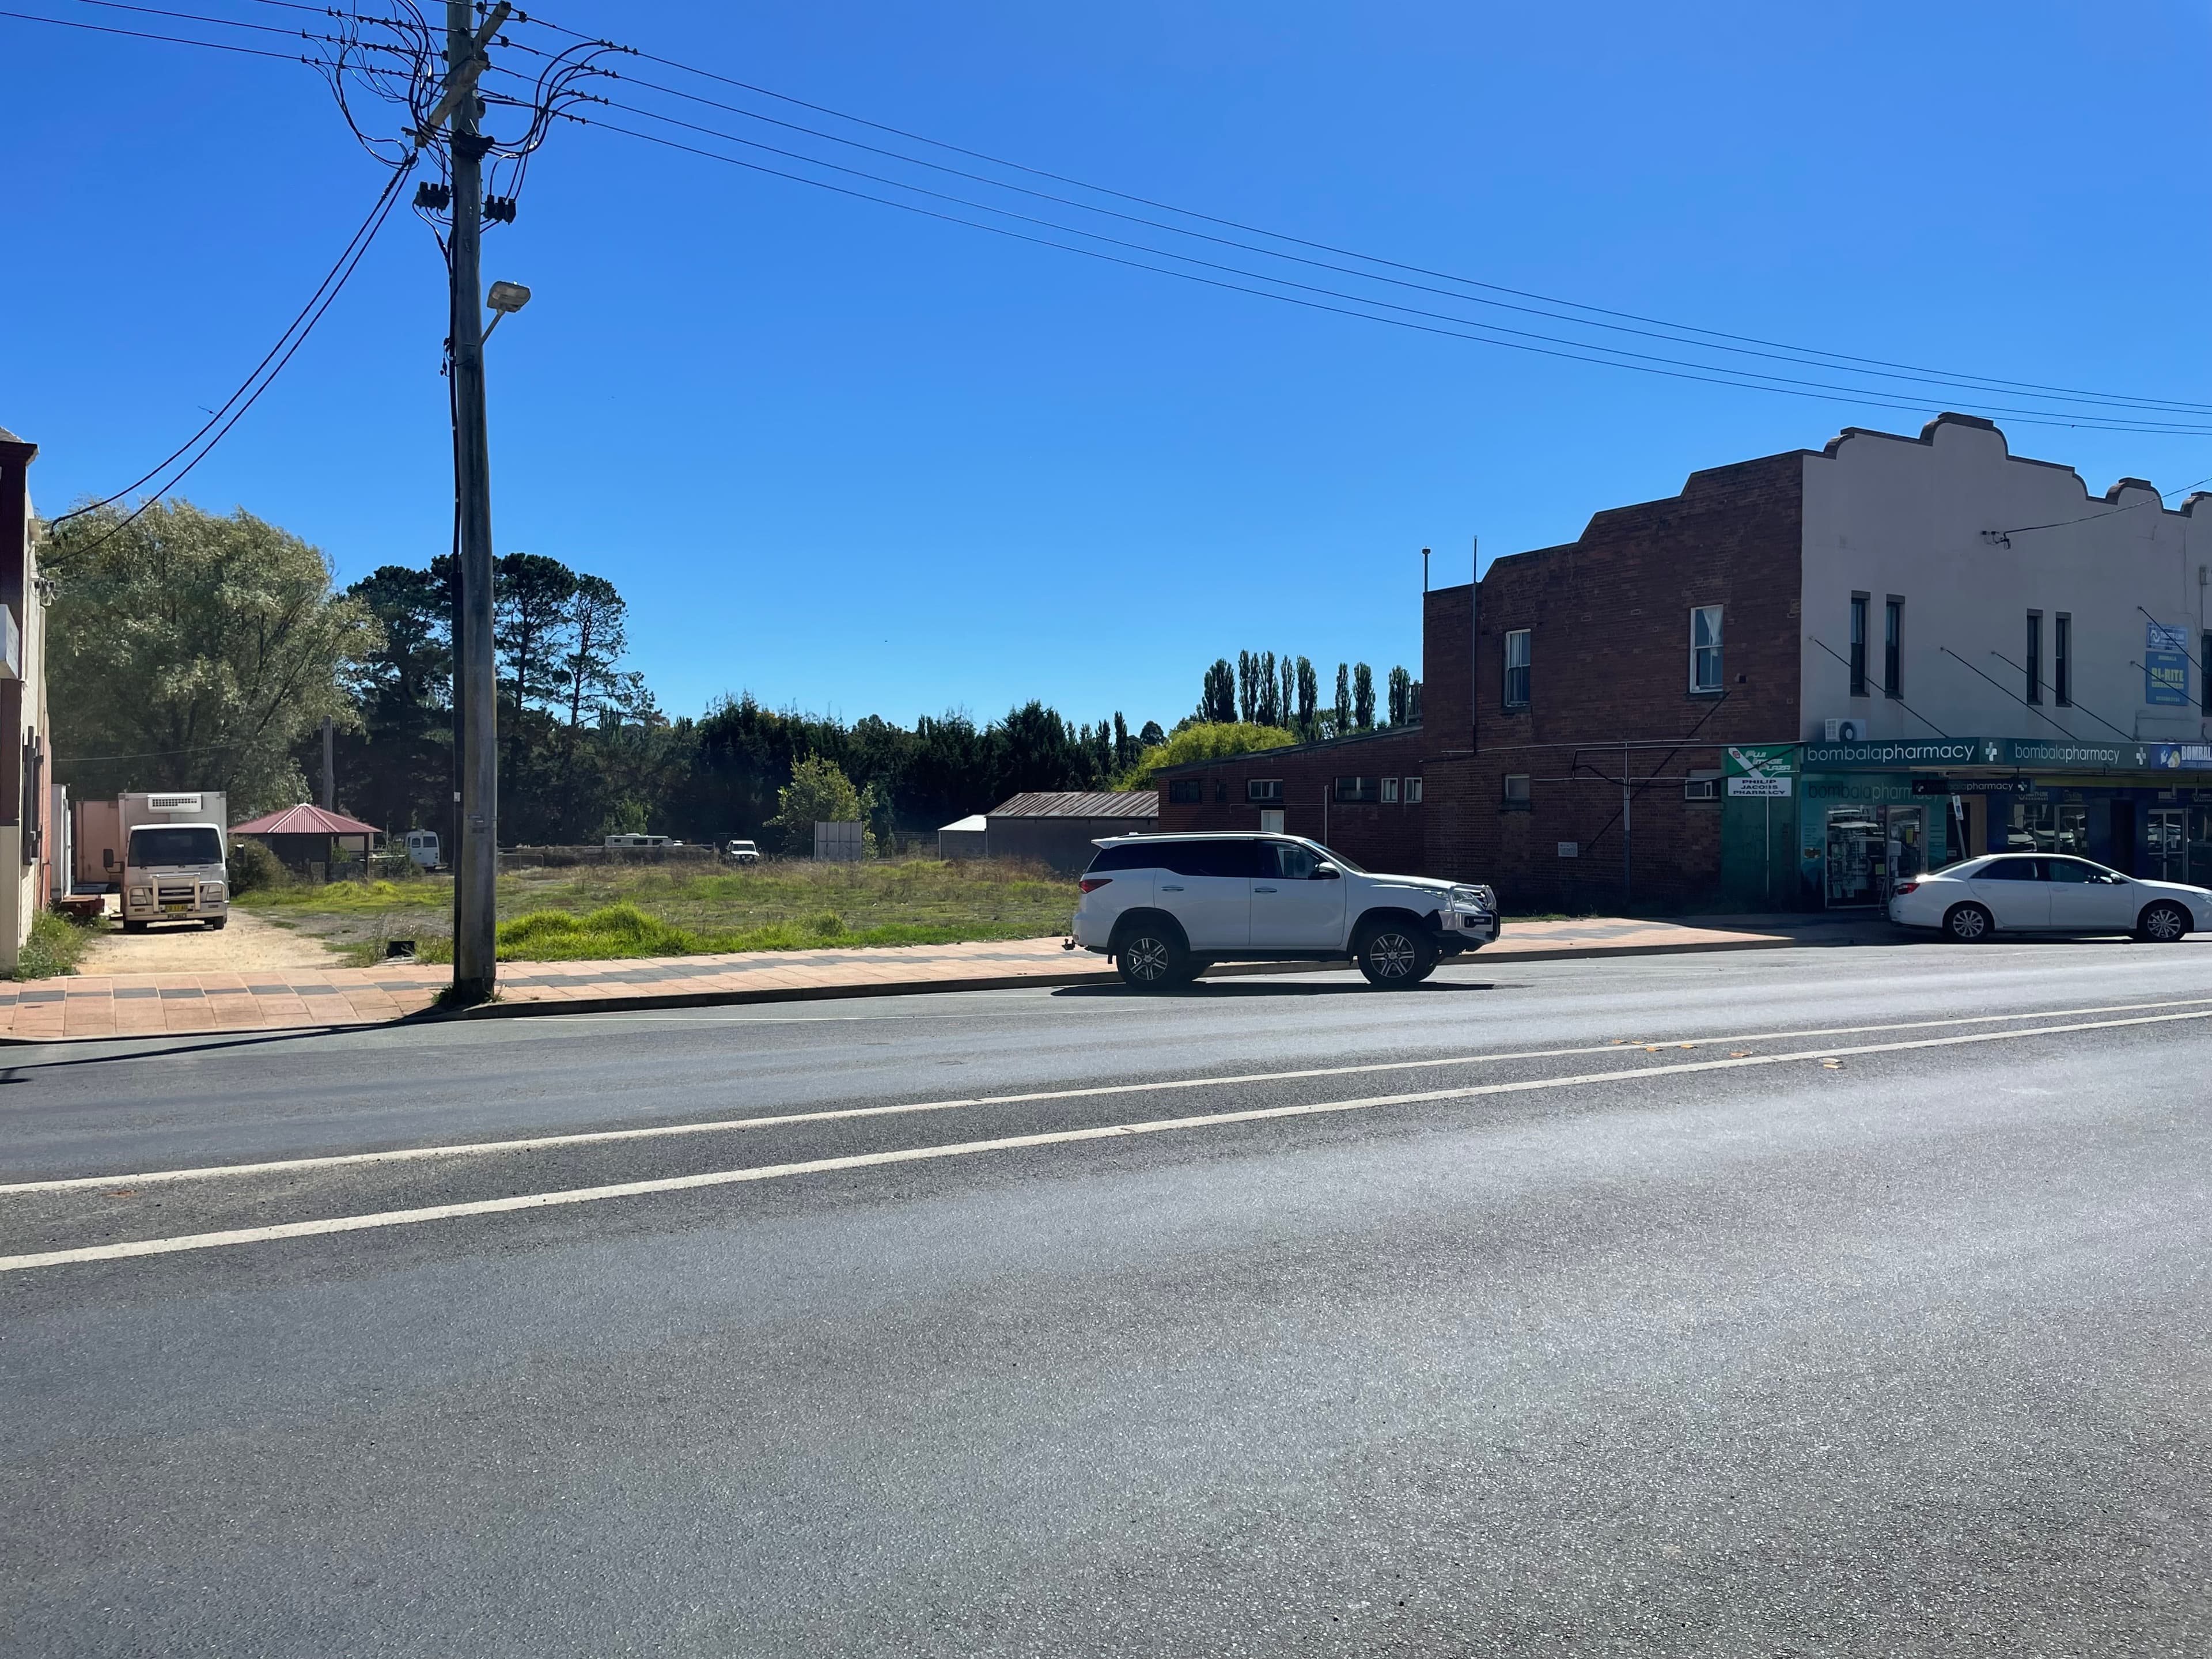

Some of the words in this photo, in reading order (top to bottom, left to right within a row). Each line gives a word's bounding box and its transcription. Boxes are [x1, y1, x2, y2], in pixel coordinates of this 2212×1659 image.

[2152, 667, 2184, 682] BI-RITE
[1807, 744, 1975, 763] bombalapharmacy
[2015, 743, 2120, 764] bombalapharmacy
